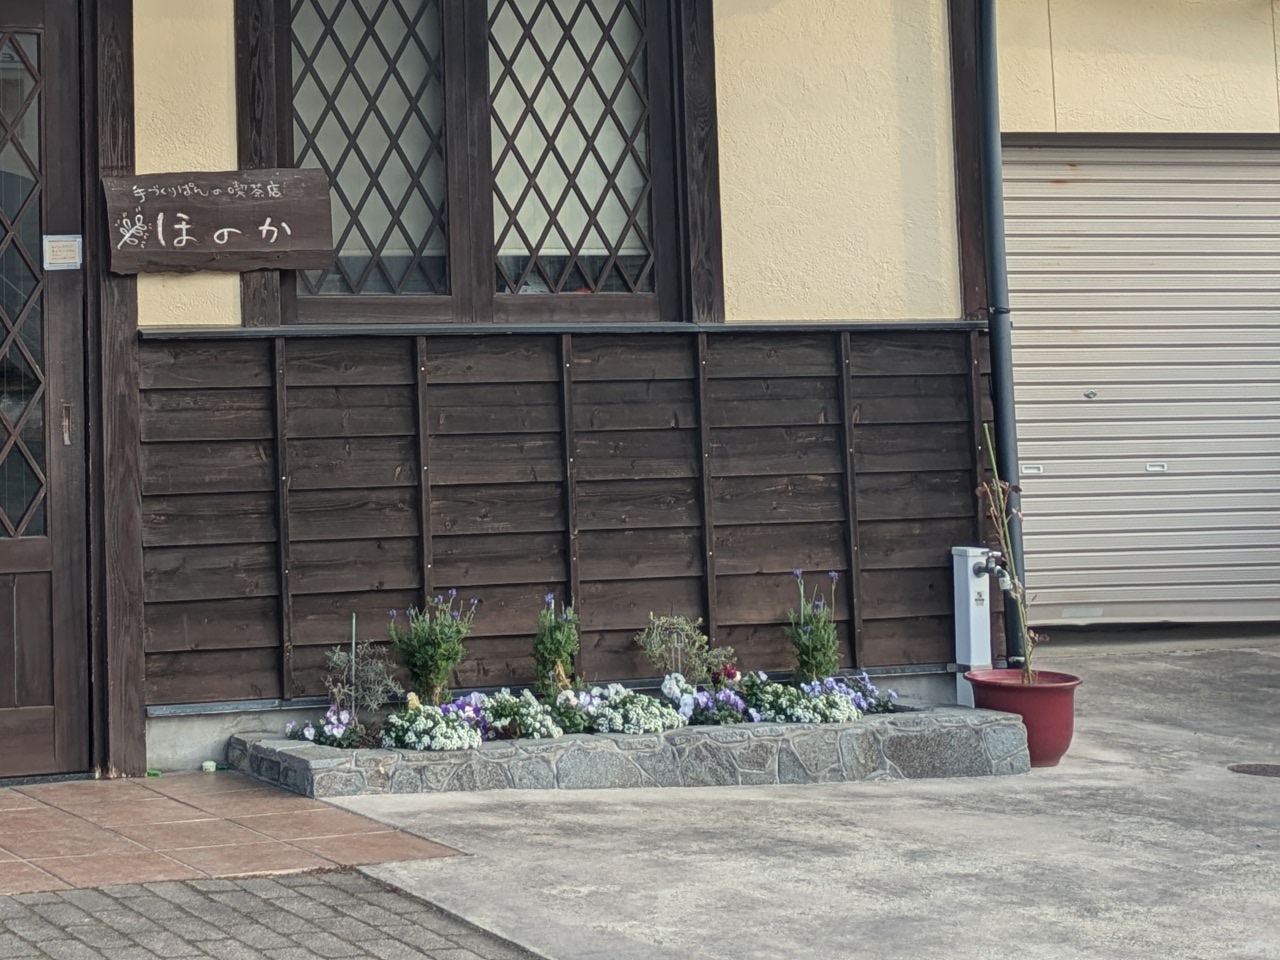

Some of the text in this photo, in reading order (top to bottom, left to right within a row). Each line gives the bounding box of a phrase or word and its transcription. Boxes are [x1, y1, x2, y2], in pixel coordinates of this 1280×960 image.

[132, 180, 282, 203] 手づくりぱんの喫茶店
[156, 211, 292, 247] ほのか
